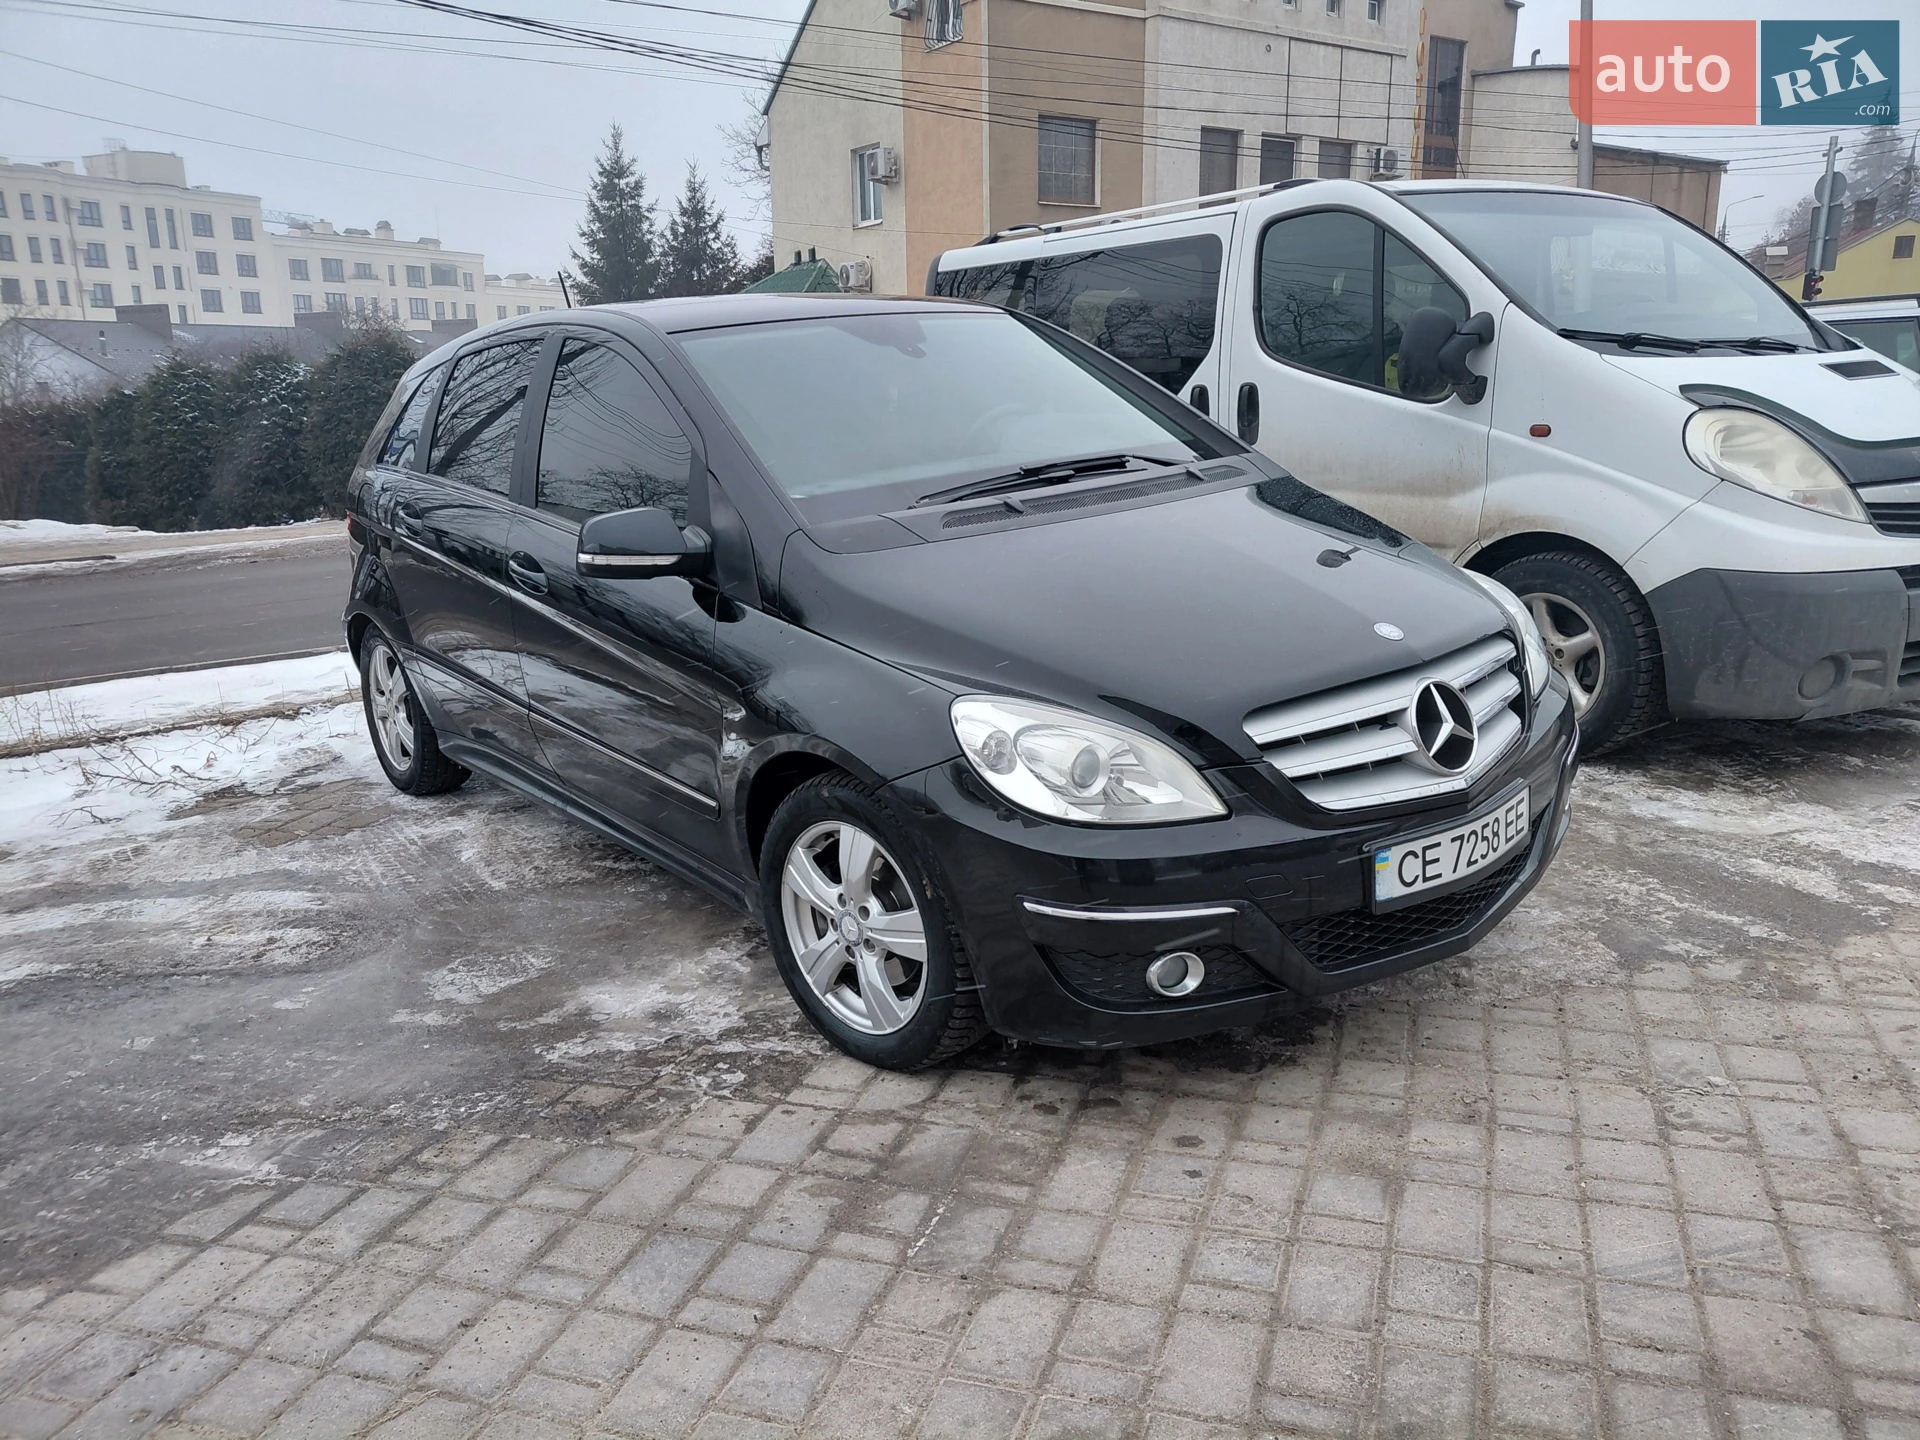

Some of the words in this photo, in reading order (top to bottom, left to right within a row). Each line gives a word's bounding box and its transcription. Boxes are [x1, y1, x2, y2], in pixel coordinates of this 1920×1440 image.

[1398, 842, 1443, 888] CE
[1450, 816, 1501, 875] 7258
[1505, 796, 1526, 845] EE
